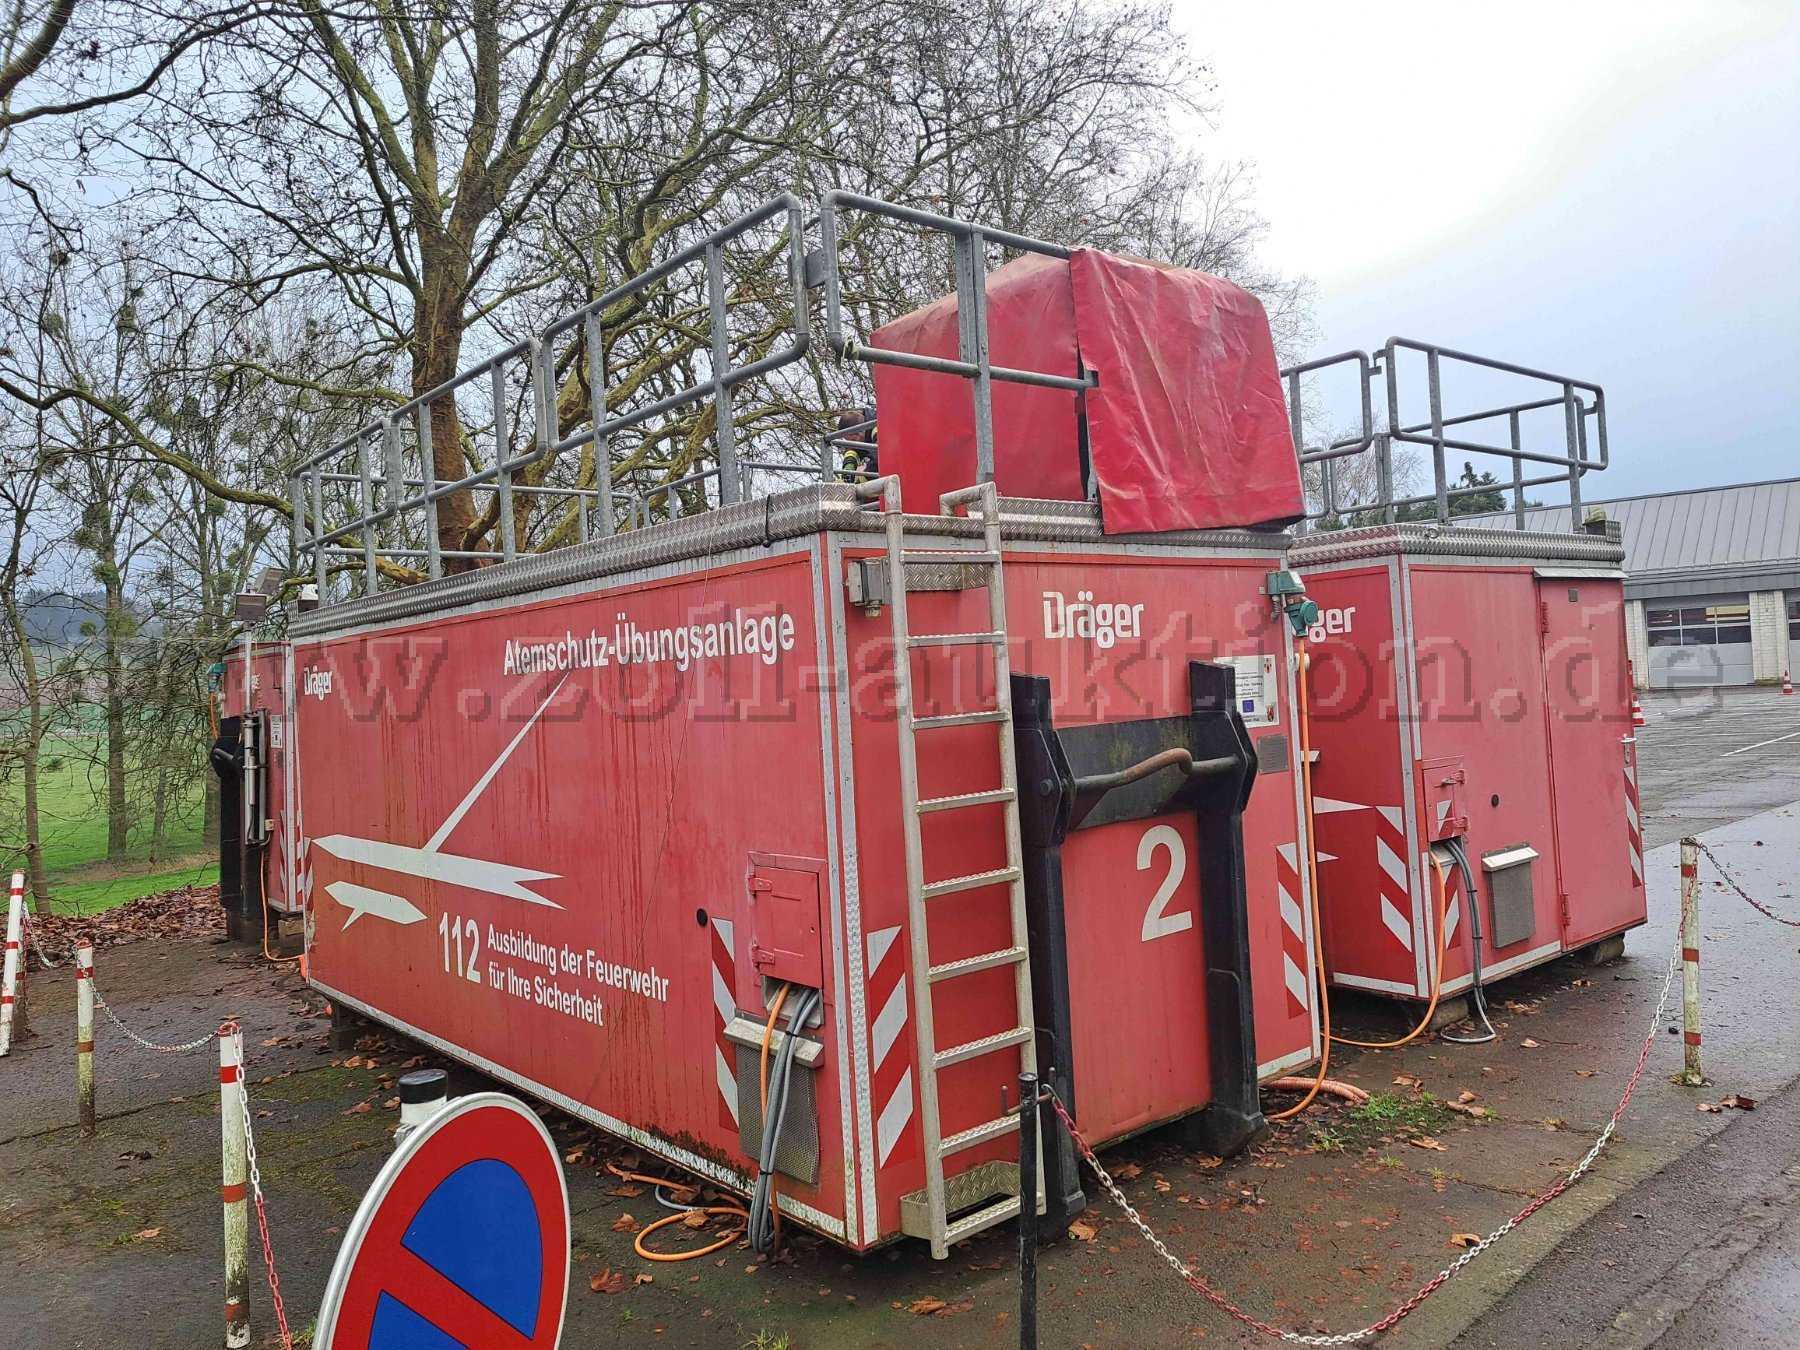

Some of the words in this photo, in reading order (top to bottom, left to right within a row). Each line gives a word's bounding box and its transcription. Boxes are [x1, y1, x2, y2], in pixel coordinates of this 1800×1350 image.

[504, 608, 795, 676] Atemschutz-Übungsanlage
[1043, 590, 1144, 648] Dräger
[1136, 824, 1193, 942] 2
[439, 911, 481, 984] 112
[487, 923, 557, 976] Ausbildung
[560, 943, 583, 976] der
[586, 949, 670, 1002] Feuerwehr
[488, 961, 505, 991] für
[507, 967, 531, 1001] Ihre
[534, 977, 604, 1027] Sicherheit
